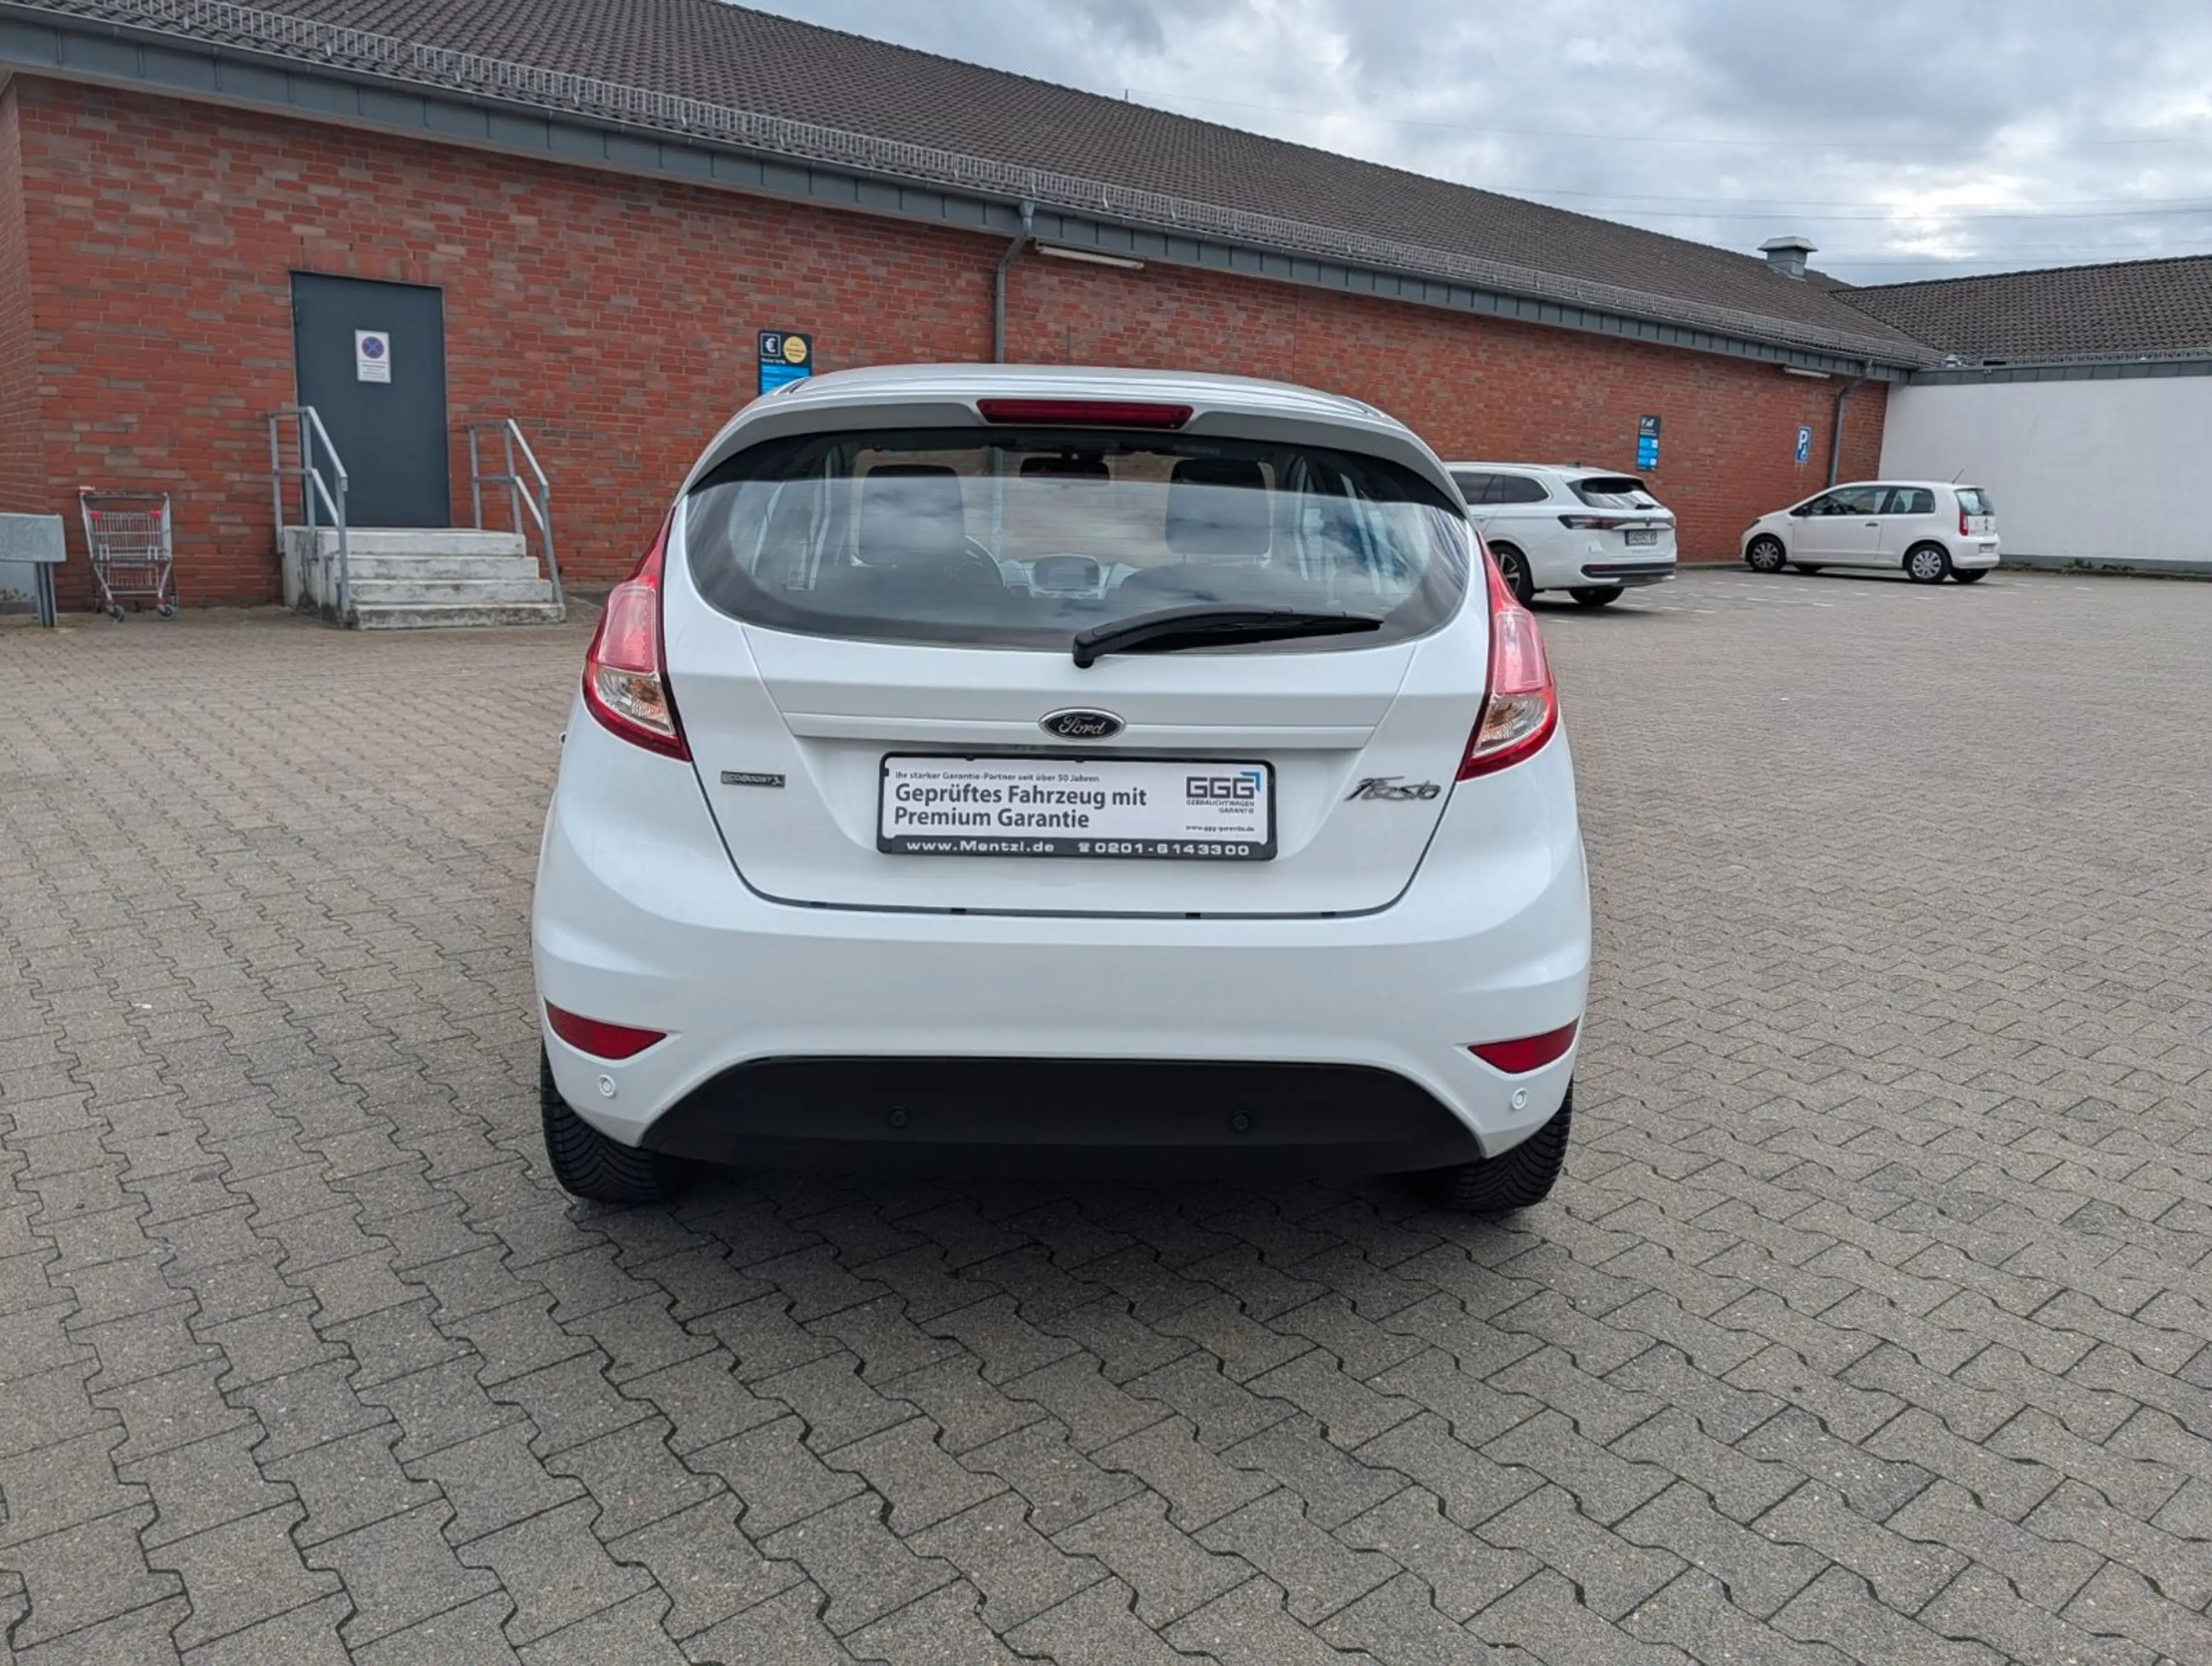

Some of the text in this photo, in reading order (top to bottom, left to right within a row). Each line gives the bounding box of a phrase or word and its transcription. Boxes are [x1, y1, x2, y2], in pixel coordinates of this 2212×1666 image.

[1798, 430, 1808, 448] P
[1058, 716, 1106, 734] Ford
[942, 772, 1016, 781] Garantie-Partner
[896, 783, 1147, 810] Geprüftes Fahrzeug mit
[1186, 777, 1254, 799] GGG
[895, 806, 1089, 828] Premium Garantie
